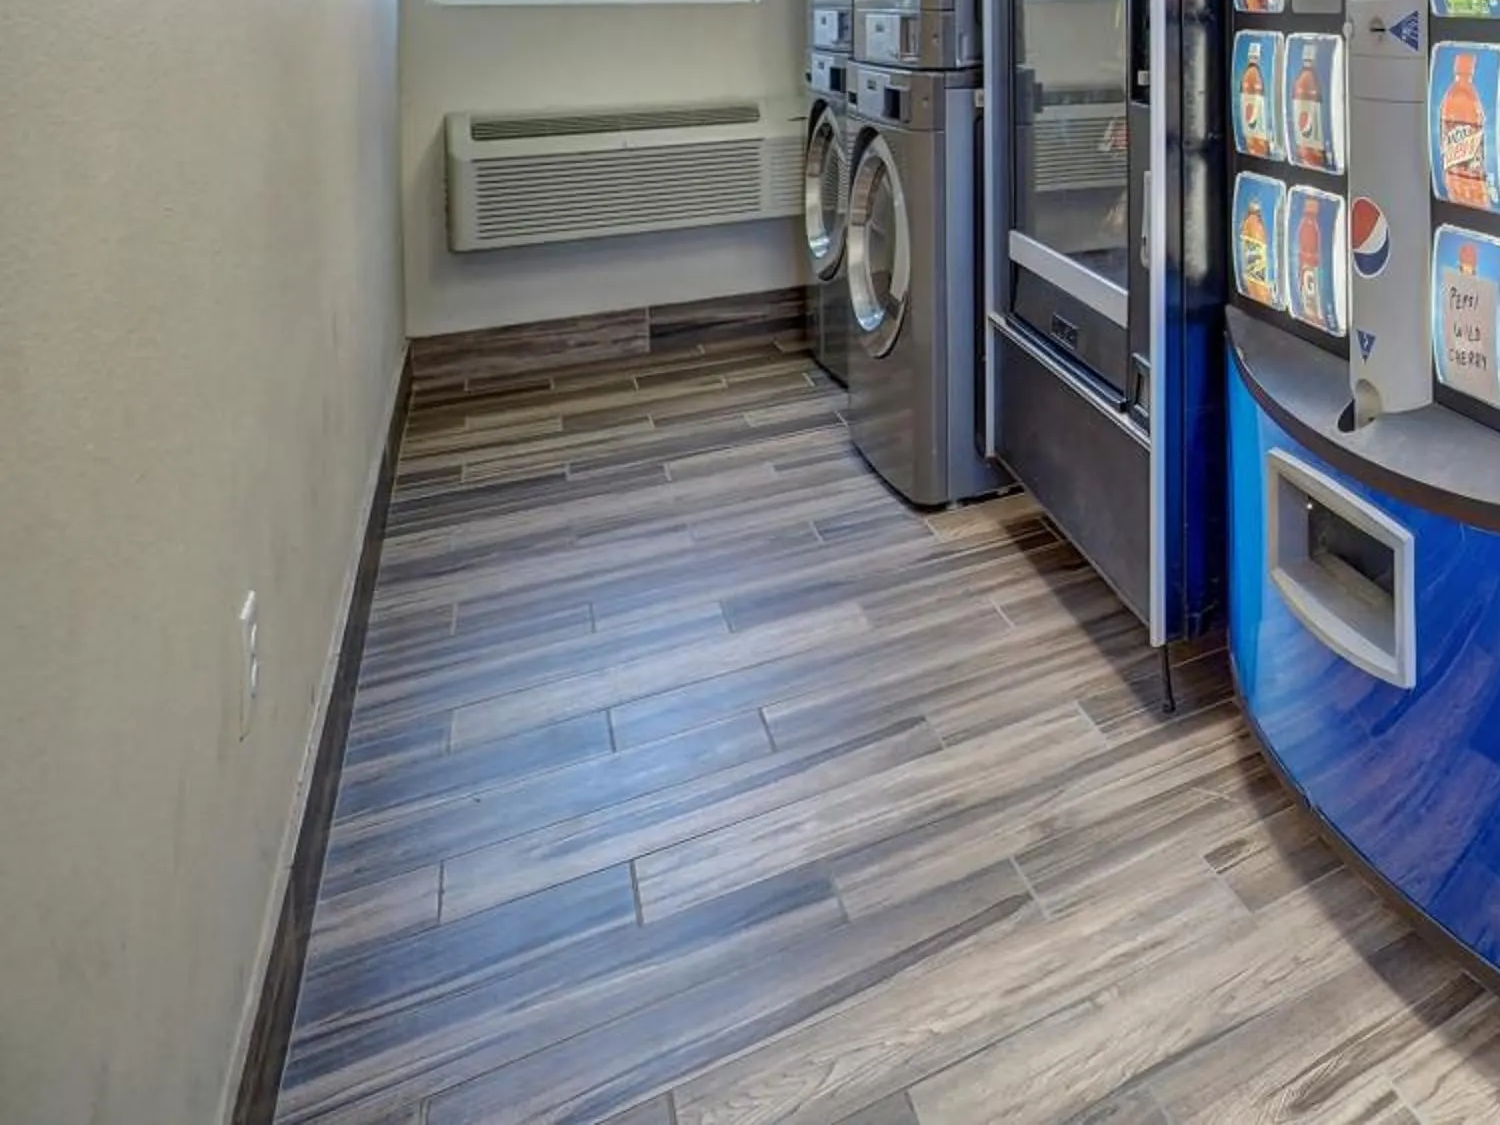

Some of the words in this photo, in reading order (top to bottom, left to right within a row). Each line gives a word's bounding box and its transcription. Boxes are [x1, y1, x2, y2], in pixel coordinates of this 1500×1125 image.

[1449, 286, 1479, 311] PEPSI
[1453, 323, 1481, 341] WILD
[1449, 348, 1488, 371] CHERRY
